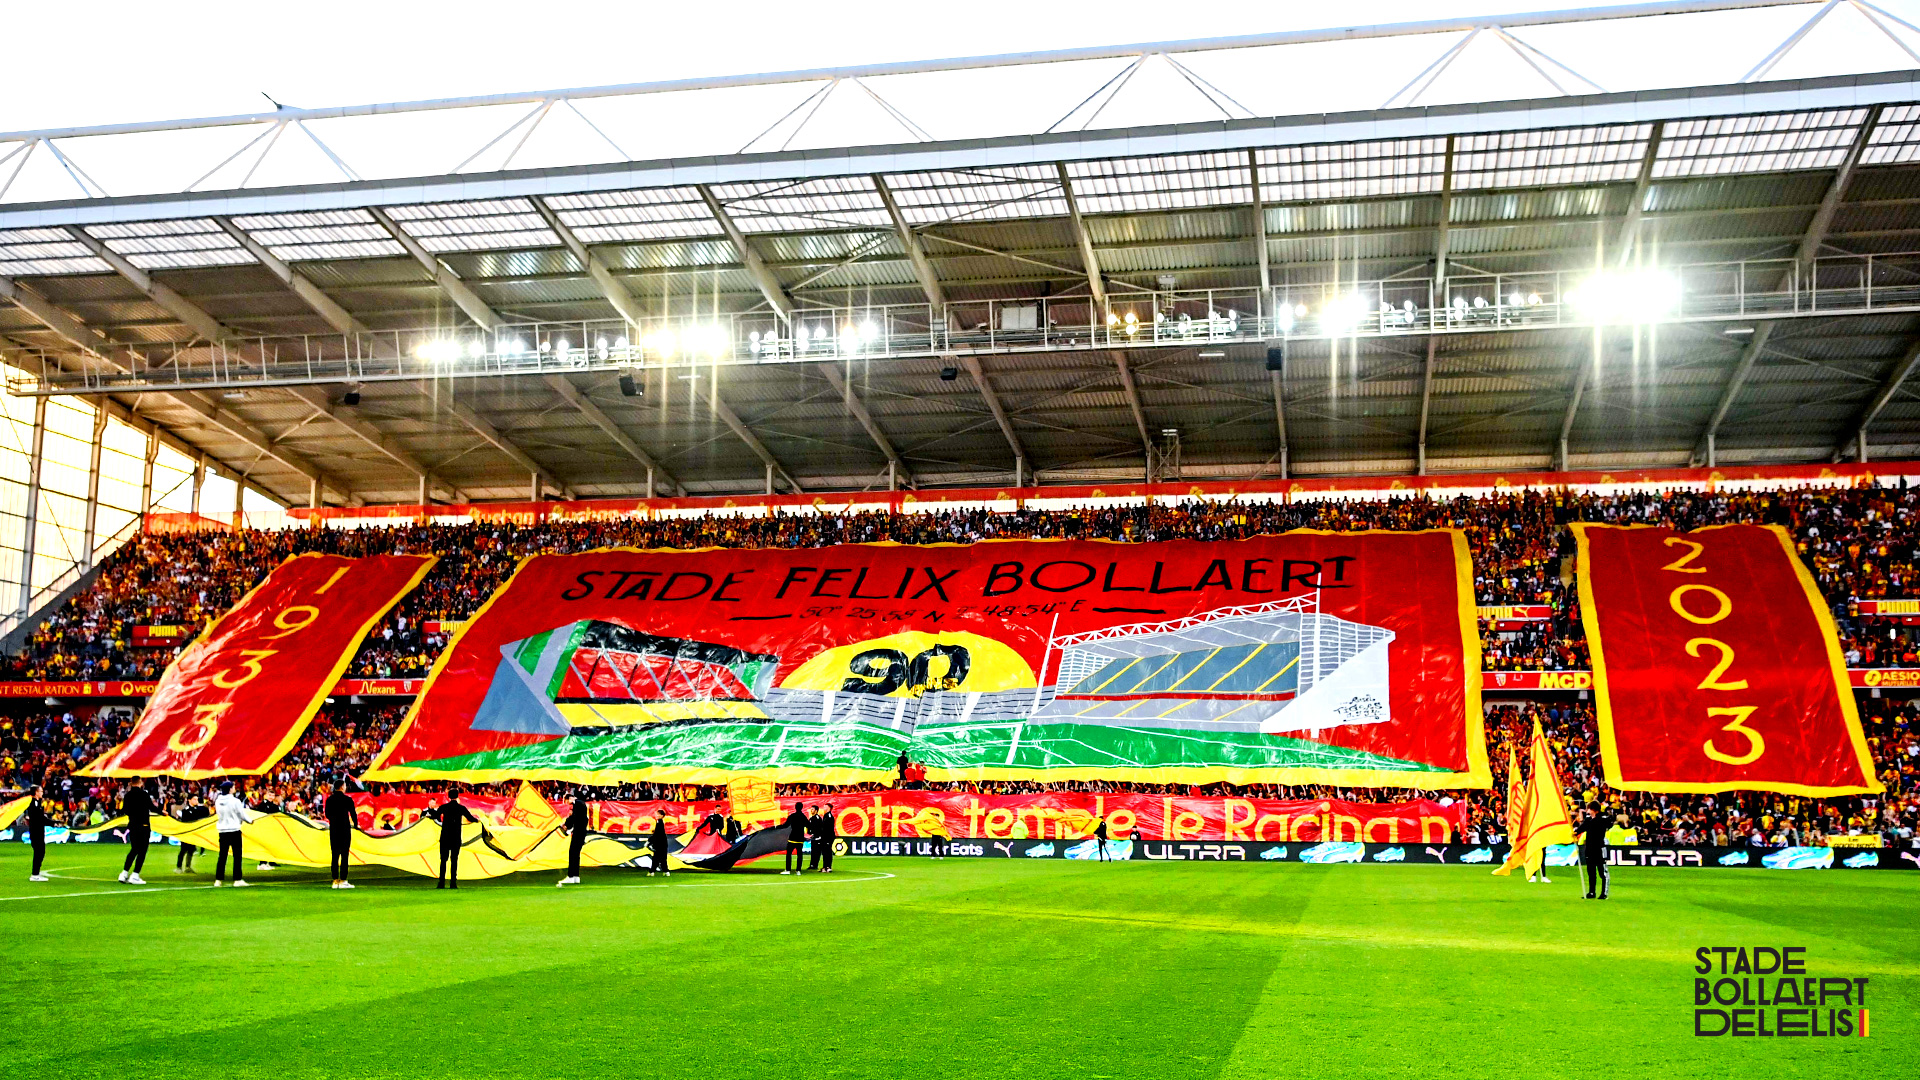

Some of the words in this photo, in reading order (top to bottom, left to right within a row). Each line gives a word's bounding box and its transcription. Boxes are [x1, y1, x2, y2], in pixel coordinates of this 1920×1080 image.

[561, 569, 755, 601] STADE
[775, 565, 963, 602] FELIX
[983, 556, 1356, 598] BOLLAERT
[149, 625, 178, 637] PUMA
[167, 565, 351, 753] 1933
[1660, 536, 1766, 766] 2023
[841, 643, 971, 697] 90
[12, 684, 80, 695] RESTAURATION
[358, 681, 396, 694] Nexans
[1163, 797, 1205, 841] le
[851, 841, 900, 854] LIGUE
[950, 842, 984, 856] Eats
[1143, 844, 1246, 860] ULTRA
